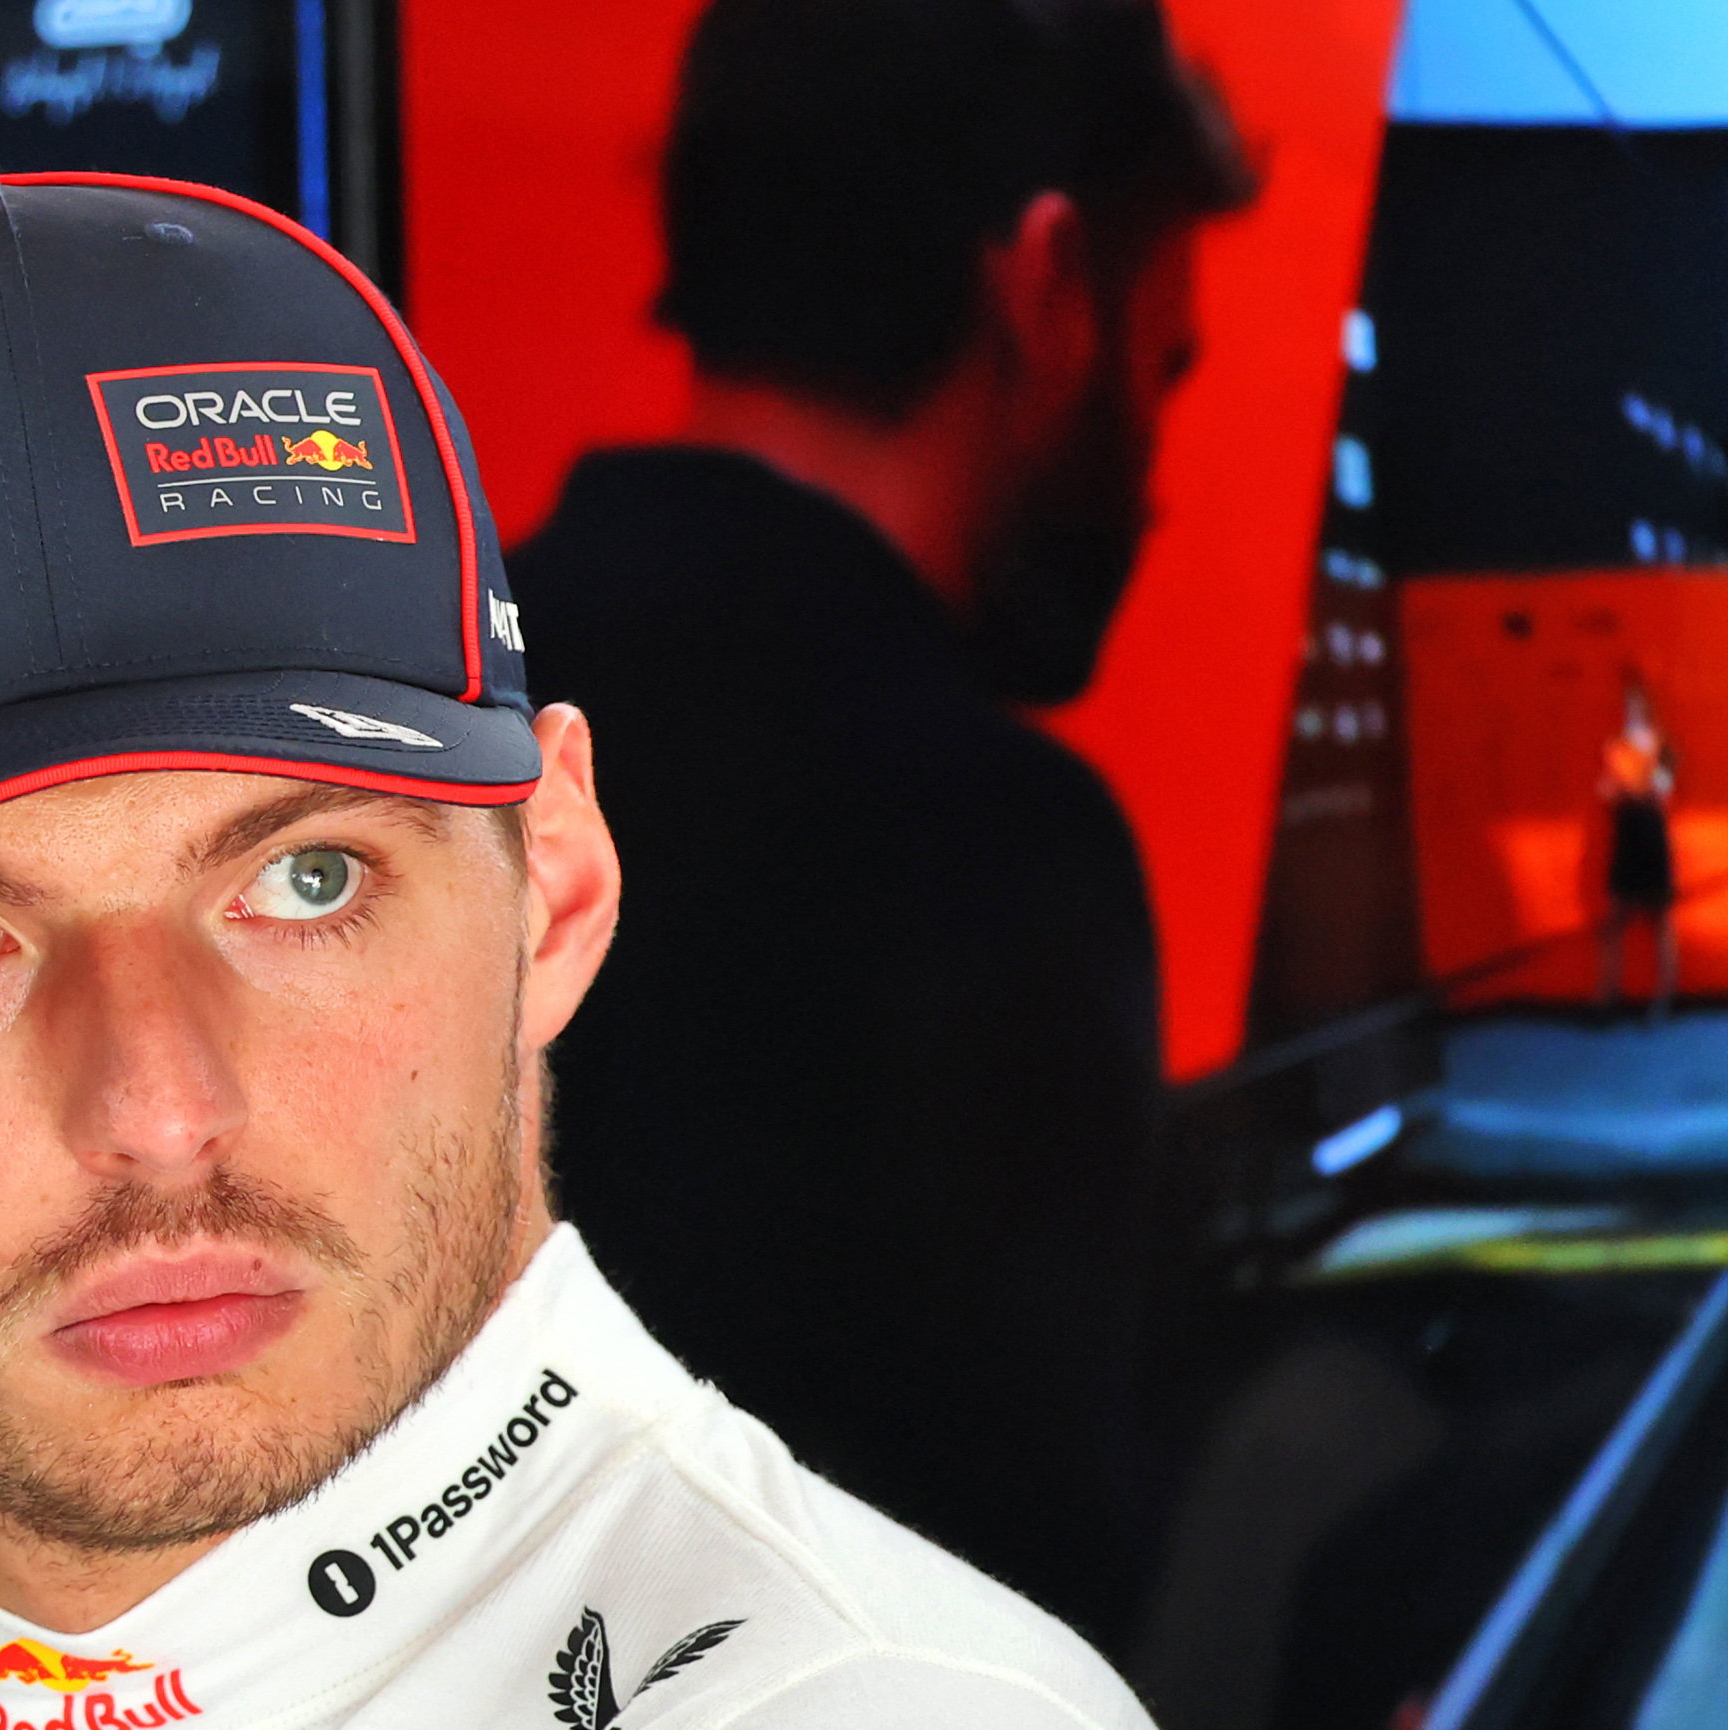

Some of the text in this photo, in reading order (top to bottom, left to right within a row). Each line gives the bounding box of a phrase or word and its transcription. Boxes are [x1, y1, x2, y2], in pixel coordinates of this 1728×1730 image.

[135, 389, 362, 429] ORACLE
[160, 485, 383, 513] RACING
[370, 1368, 579, 1571] 1Password
